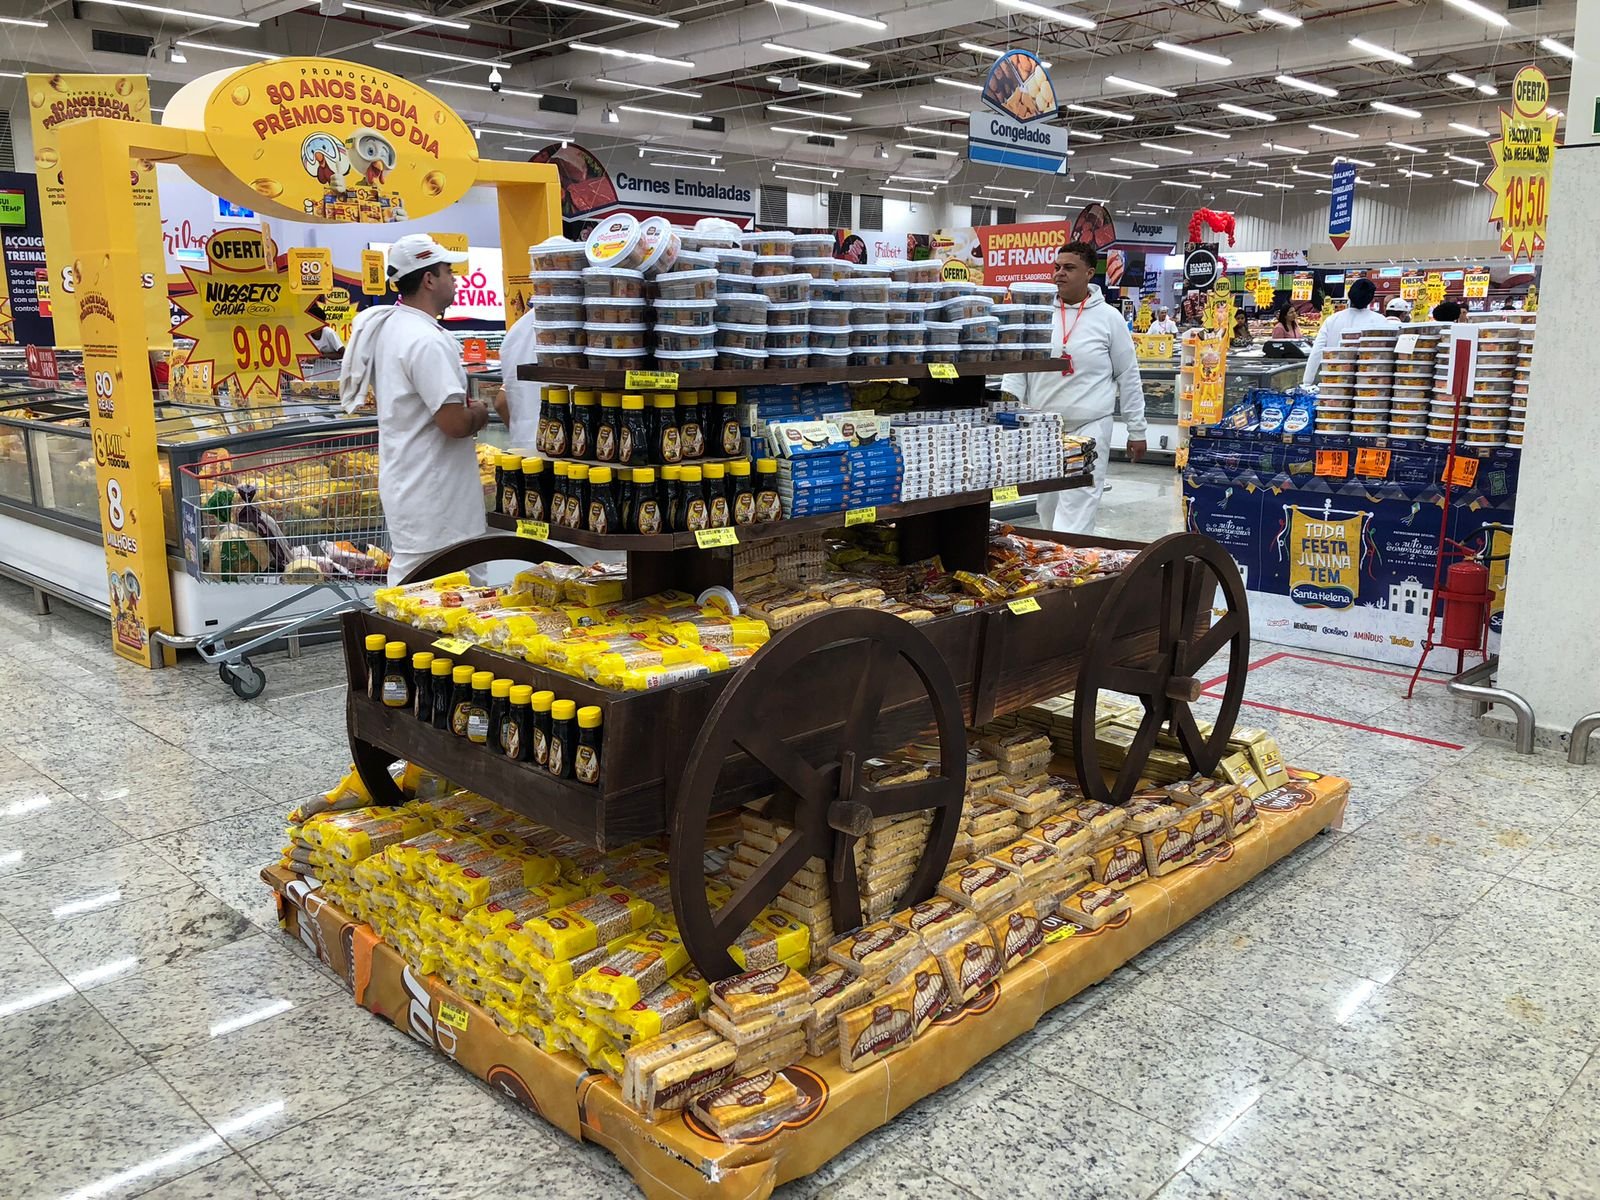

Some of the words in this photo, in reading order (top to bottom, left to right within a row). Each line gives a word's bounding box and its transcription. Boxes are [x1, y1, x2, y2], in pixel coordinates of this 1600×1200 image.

[301, 68, 389, 89] PROMOÇÃO
[1516, 80, 1546, 102] OFERTA
[66, 96, 96, 108] ANOS
[98, 97, 130, 114] SADIA
[266, 81, 294, 106] 80
[300, 78, 357, 100] ANOS
[360, 85, 420, 124] SADIA
[89, 108, 120, 120] TODO
[252, 104, 346, 140] PRÊMIOS
[347, 106, 406, 137] TODO
[408, 129, 440, 159] DIA
[991, 120, 1050, 144] Congelados
[1334, 170, 1354, 180] BALANÇA
[616, 172, 671, 194] Carnes
[674, 179, 751, 202] Embaladas
[1506, 176, 1545, 230] 19,50
[1132, 222, 1162, 236] Açougue
[5, 236, 44, 249] AÇOUG
[988, 230, 1066, 250] EMPANADOS
[988, 250, 1006, 267] DE
[301, 261, 322, 276] 80
[944, 268, 968, 280] OFERTA
[206, 283, 281, 302] NUGGETS
[212, 302, 246, 316] SADIA
[233, 324, 291, 370] 9,80
[96, 370, 112, 398] 80
[98, 399, 114, 412] REAIS
[94, 428, 106, 466] 8
[105, 434, 126, 460] MIL
[106, 478, 126, 532] 8
[1304, 523, 1345, 538] TODA
[106, 532, 138, 554] MILHÕES
[1302, 538, 1348, 554] FESTA
[1297, 552, 1350, 569] JUNINA
[1310, 568, 1340, 584] TEM
[1292, 589, 1318, 600] Santa
[1318, 591, 1350, 603] Helena
[1108, 866, 1128, 880] Torrone
[1007, 936, 1028, 955] Torrone
[747, 965, 783, 984] Torrone
[962, 966, 986, 986] Torrone
[916, 995, 936, 1019] Torrone
[859, 1031, 890, 1054] Torrone
[734, 1073, 769, 1091] Torrone
